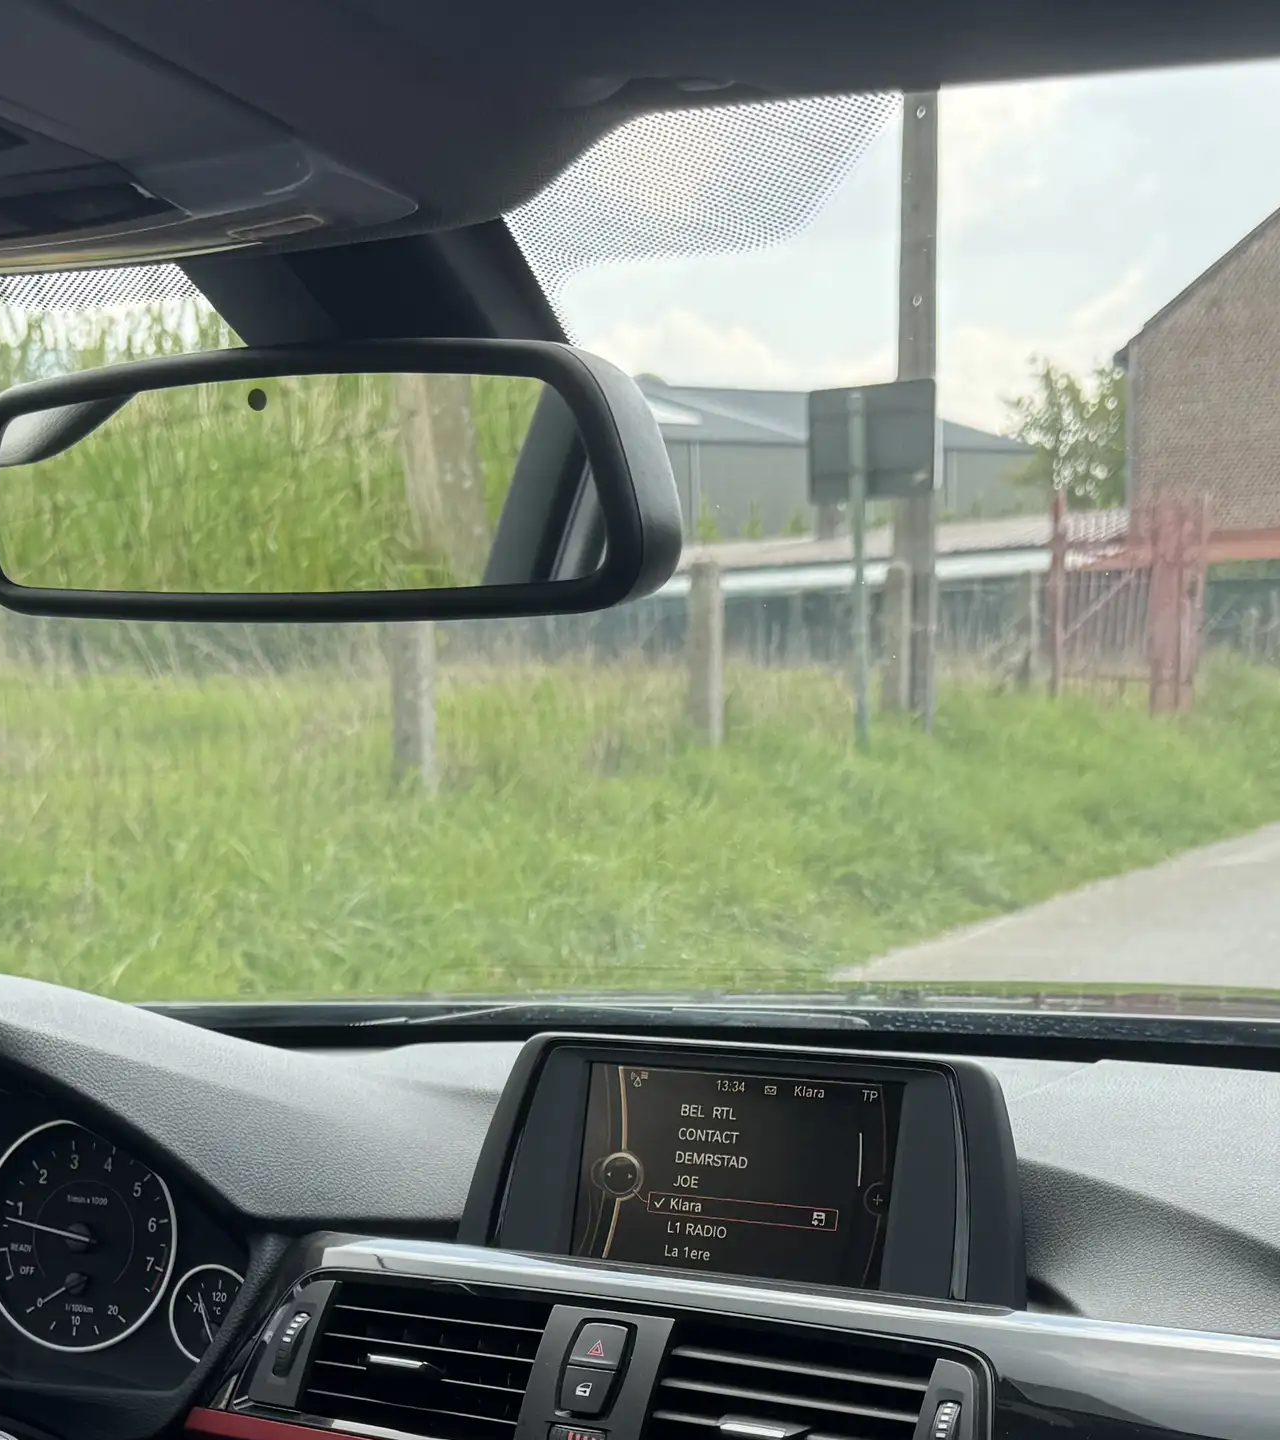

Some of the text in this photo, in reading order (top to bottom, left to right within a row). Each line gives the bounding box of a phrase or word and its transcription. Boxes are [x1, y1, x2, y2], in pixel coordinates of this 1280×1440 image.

[716, 1079, 746, 1093] 13:34
[793, 1086, 826, 1099] Klara
[861, 1089, 879, 1102] TP
[680, 1103, 737, 1121] BEL RTL
[677, 1127, 740, 1145] CONTACT
[69, 1154, 79, 1169] 3
[103, 1157, 113, 1172] 4
[674, 1150, 749, 1170] DEMRSTAD
[38, 1169, 48, 1185] 2
[672, 1175, 700, 1190] JOE
[132, 1181, 142, 1197] 5
[16, 1201, 24, 1216] 1
[669, 1197, 703, 1213] Klara
[147, 1217, 157, 1233] 6
[666, 1221, 728, 1240] L1 RADIO
[664, 1244, 712, 1262] La 1ere
[20, 1265, 35, 1276] OFF
[146, 1256, 155, 1272] 7
[212, 1291, 228, 1303] 120
[107, 1304, 119, 1316] 20
[71, 1315, 81, 1326] 10
